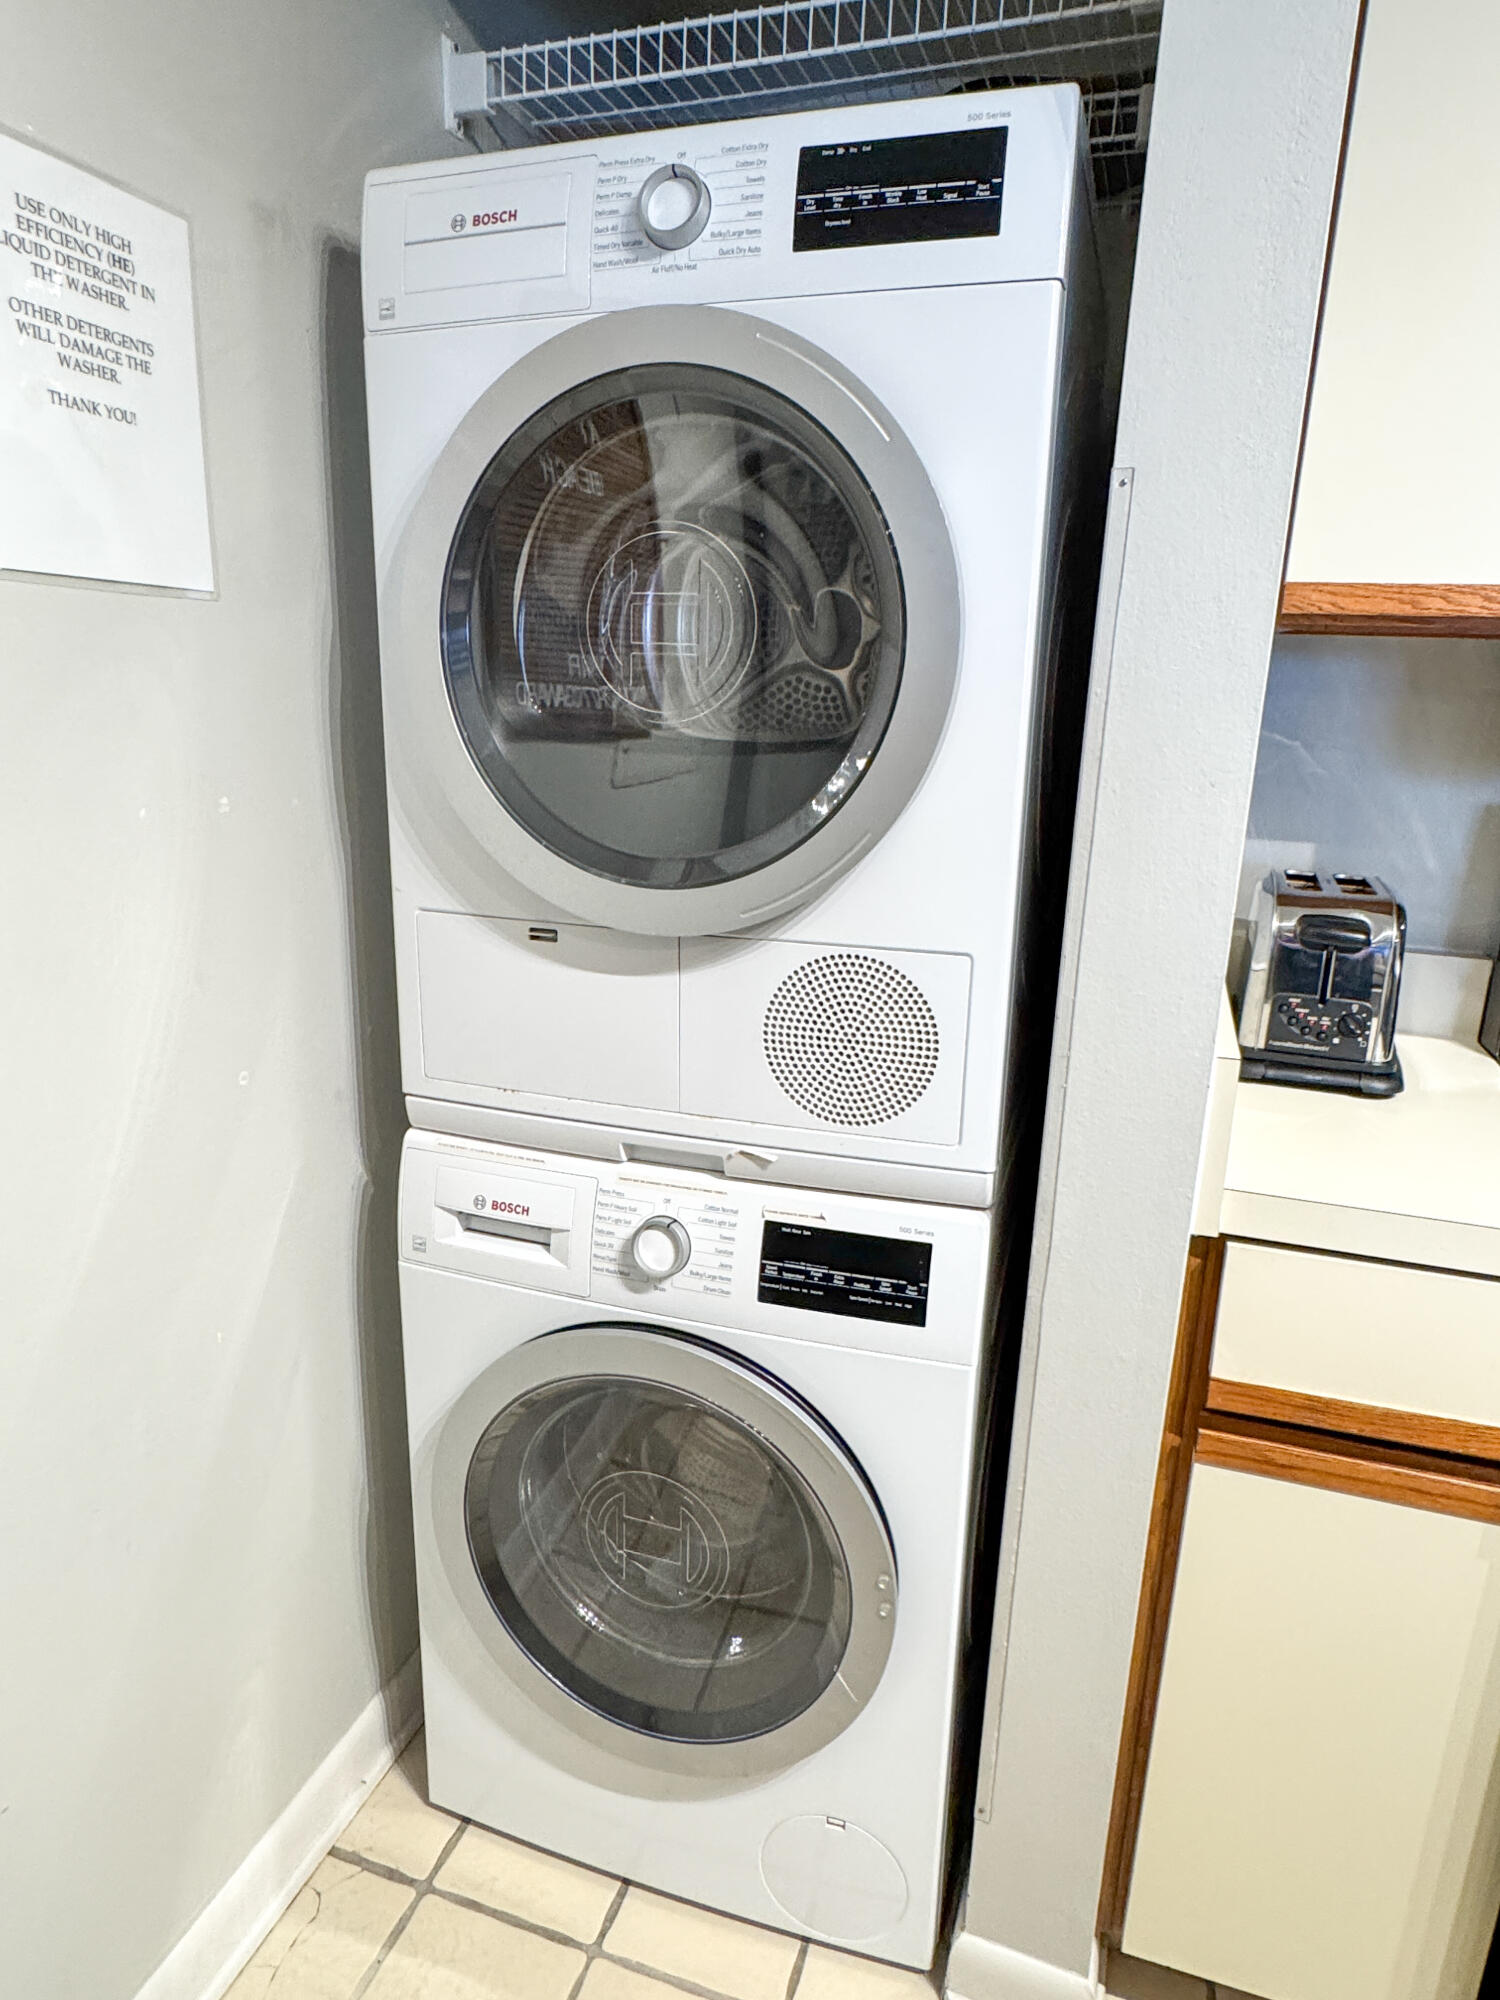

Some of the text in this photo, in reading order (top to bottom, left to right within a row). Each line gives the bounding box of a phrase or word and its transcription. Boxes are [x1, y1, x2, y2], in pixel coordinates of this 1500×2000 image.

[967, 110, 1012, 122] 500 Series
[758, 143, 769, 151] Dry
[645, 156, 656, 164] Dry
[756, 159, 767, 167] Dry
[618, 176, 627, 184] Dry
[14, 193, 132, 255] USE ONLY HIGH
[472, 209, 518, 227] BOSCH
[15, 213, 136, 277] EFFICIENCY (HE)
[735, 247, 747, 255] Dry
[31, 261, 63, 287] TH
[55, 249, 139, 295] DETERGENT
[141, 284, 156, 303] IN
[8, 296, 155, 358] OTHER DETERGENTS
[16, 318, 153, 376] WILL DAMAGE THE
[47, 389, 138, 426] THANK YOU!
[491, 1200, 530, 1216] BOSCH
[914, 1228, 935, 1237] Series
